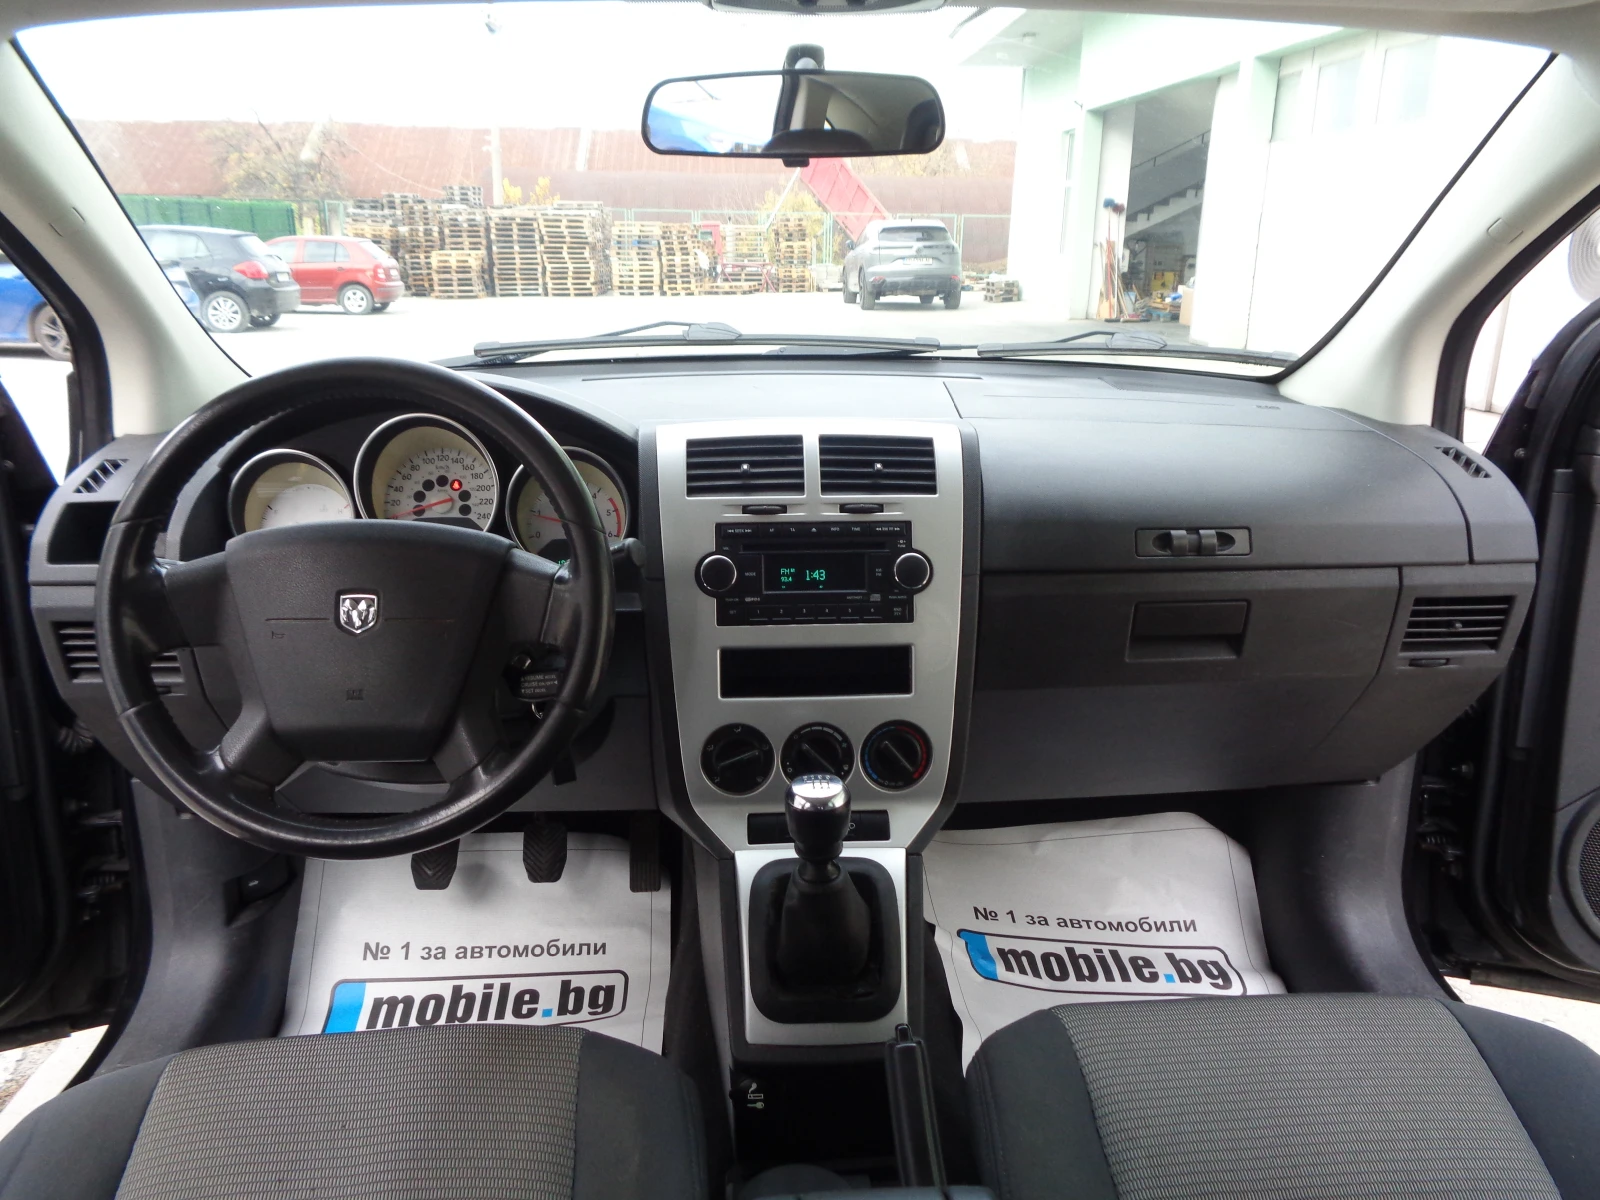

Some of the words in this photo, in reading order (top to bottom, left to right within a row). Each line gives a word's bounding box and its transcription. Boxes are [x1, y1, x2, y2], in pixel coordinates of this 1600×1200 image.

[805, 570, 826, 581] 1:43
[1006, 910, 1017, 924] 1
[1024, 912, 1050, 927] за
[1057, 915, 1198, 934] автомобили
[400, 941, 410, 960] 1
[420, 944, 446, 960] за
[454, 939, 607, 960] автомобили
[996, 946, 1234, 991] mobile.bg
[365, 979, 616, 1030] mobile.bg
